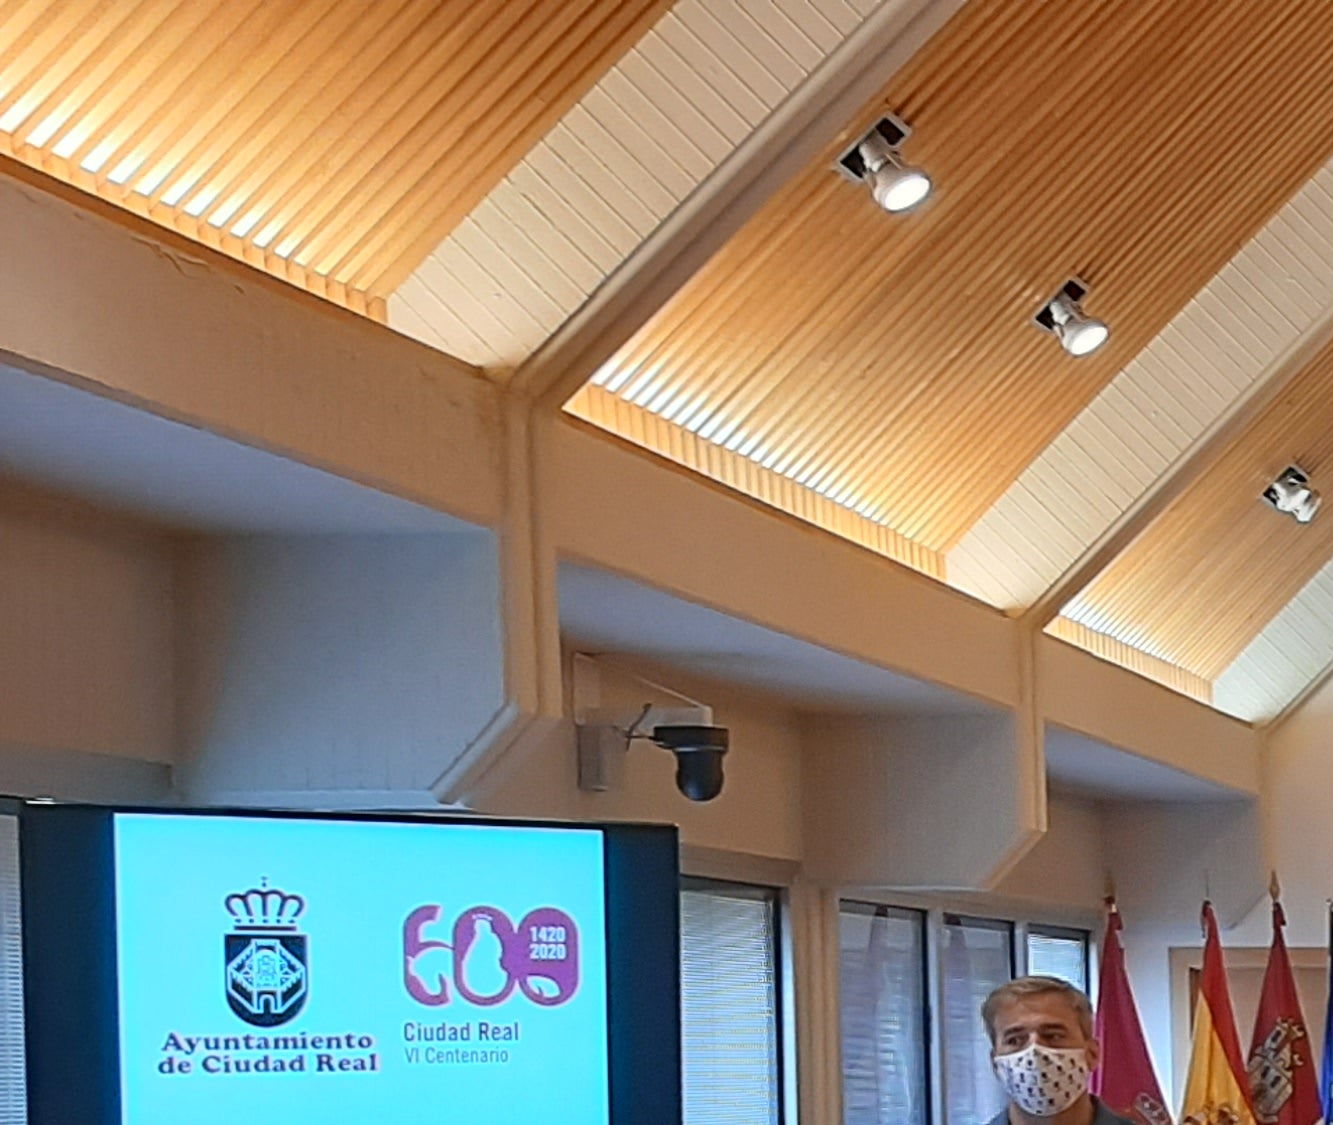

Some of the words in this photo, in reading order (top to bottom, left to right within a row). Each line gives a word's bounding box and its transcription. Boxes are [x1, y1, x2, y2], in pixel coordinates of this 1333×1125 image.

[530, 927, 567, 942] 1420
[530, 944, 567, 960] 2020
[403, 1022, 471, 1042] Ciudad
[478, 1022, 519, 1041] Real
[161, 1032, 374, 1056] Ayuntamiento
[157, 1056, 192, 1075] de
[201, 1054, 306, 1074] Ciudad
[315, 1053, 378, 1072] Real
[405, 1048, 419, 1063] VI
[425, 1047, 509, 1063] Centenario
